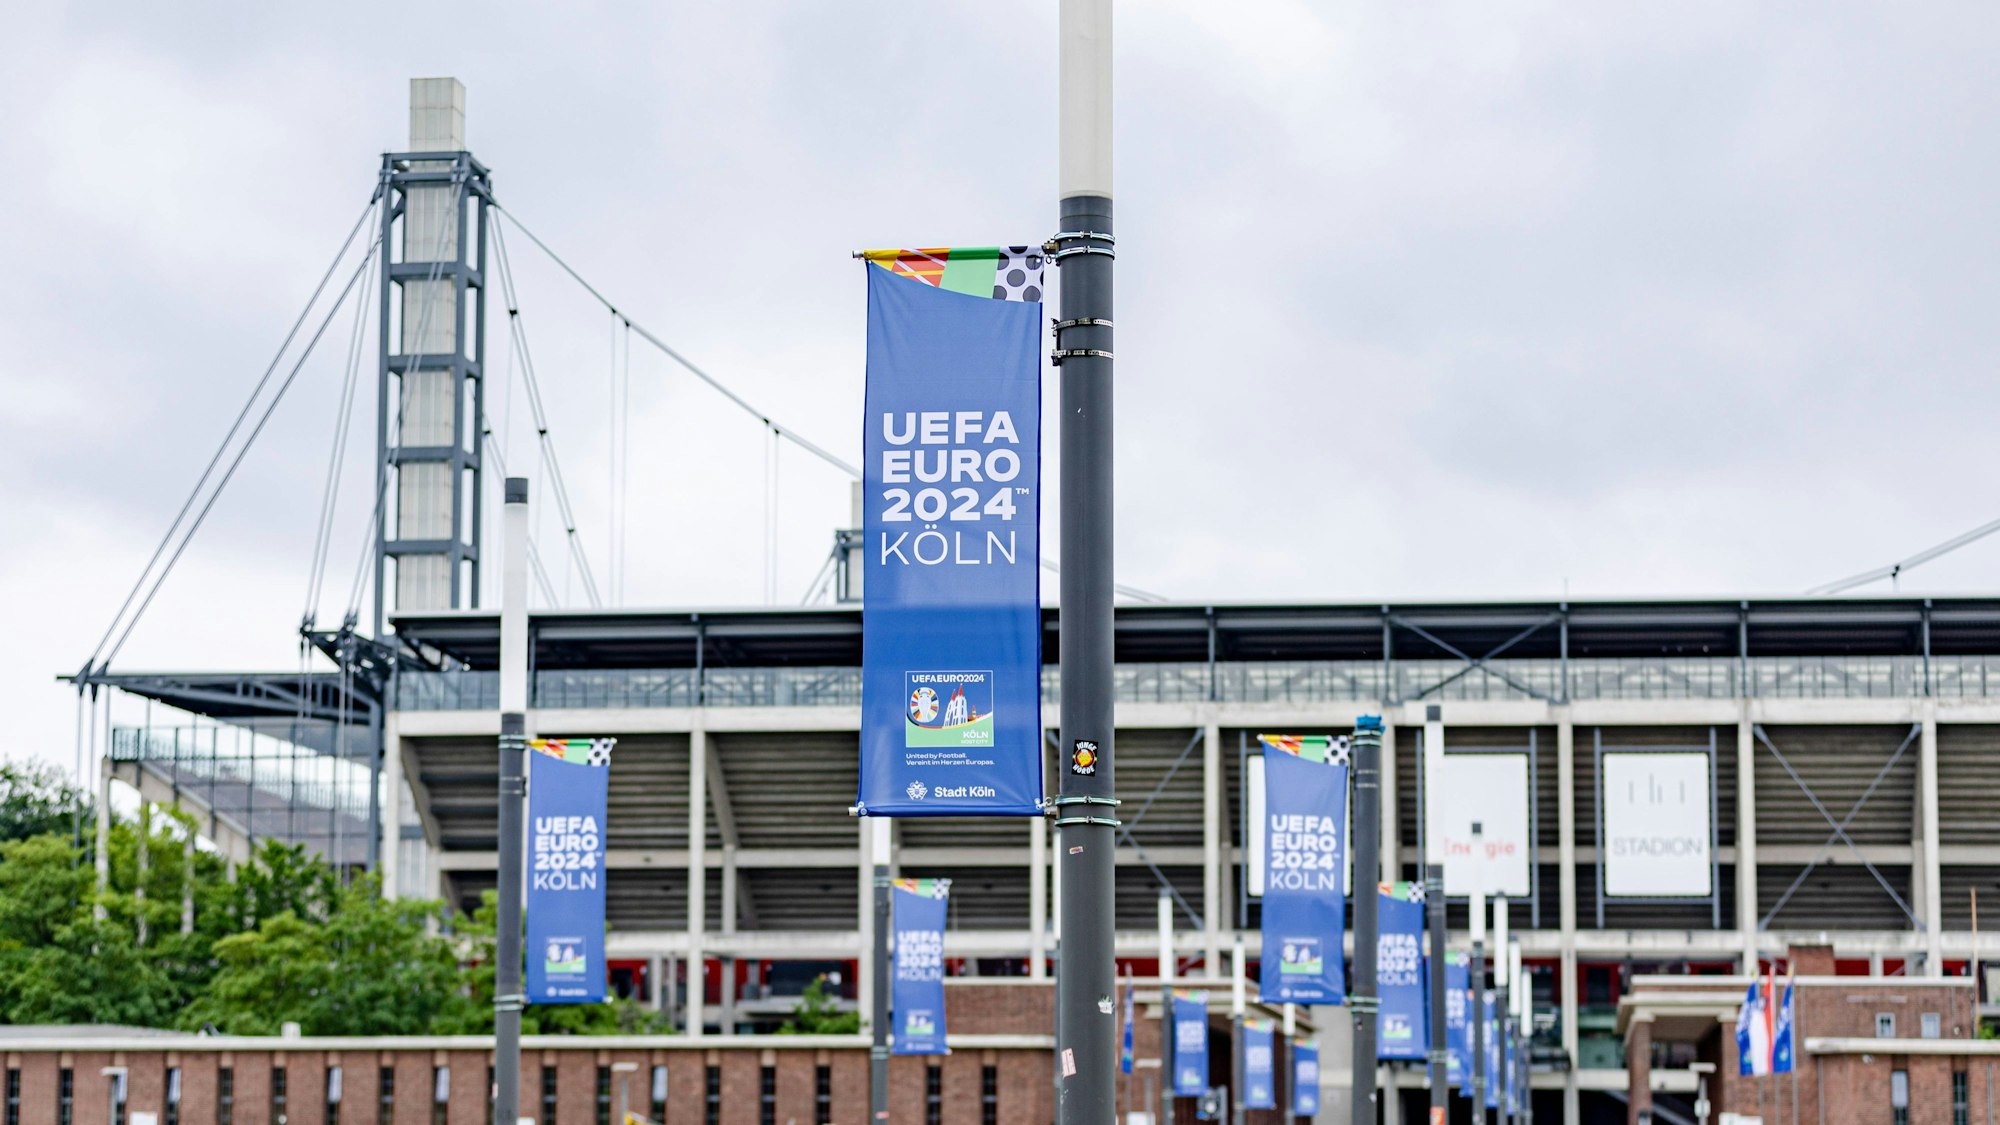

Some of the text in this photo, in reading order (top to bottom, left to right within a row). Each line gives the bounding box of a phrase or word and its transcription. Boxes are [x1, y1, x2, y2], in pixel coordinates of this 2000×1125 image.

[883, 411, 1020, 445] UEFA
[882, 449, 1021, 483] EURO
[881, 524, 1016, 566] KÖLN
[963, 730, 989, 739] KÖLN
[1076, 741, 1097, 751] JUNGE
[1072, 764, 1095, 774] HORDE
[934, 786, 996, 798] Stadt Köln
[535, 816, 598, 834] UEFA
[1271, 814, 1336, 835] UEFA
[535, 834, 599, 853] EURO
[1271, 832, 1337, 853] EURO
[1613, 837, 1704, 856] STADION
[533, 870, 597, 891] KÖLN
[1270, 869, 1335, 891] KÖLN
[898, 931, 941, 943] UEFA
[897, 943, 942, 955] EURO
